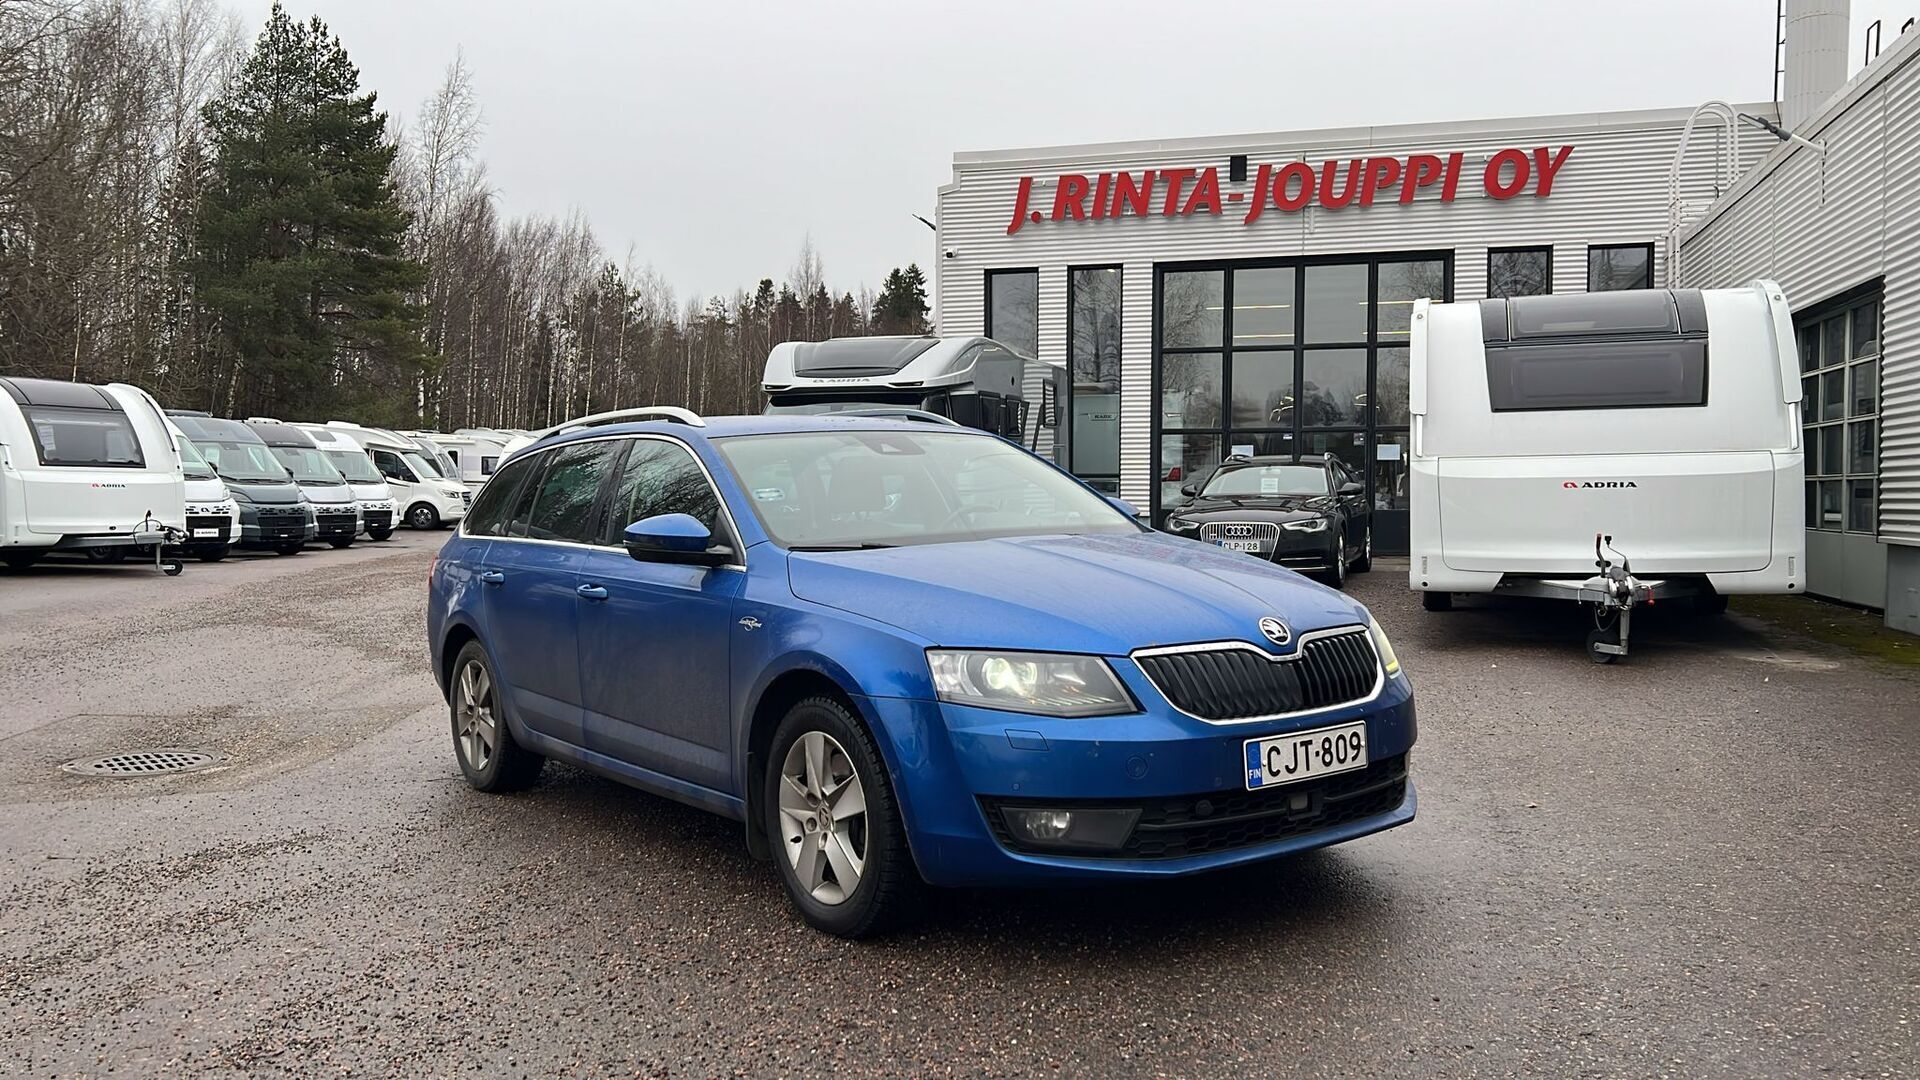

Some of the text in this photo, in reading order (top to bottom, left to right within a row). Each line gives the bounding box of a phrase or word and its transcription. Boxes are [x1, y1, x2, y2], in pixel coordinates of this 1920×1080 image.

[1483, 145, 1575, 200] OY
[1581, 481, 1637, 489] ADRIA
[1267, 731, 1361, 777] CJT-809
[1248, 767, 1261, 780] FIN
